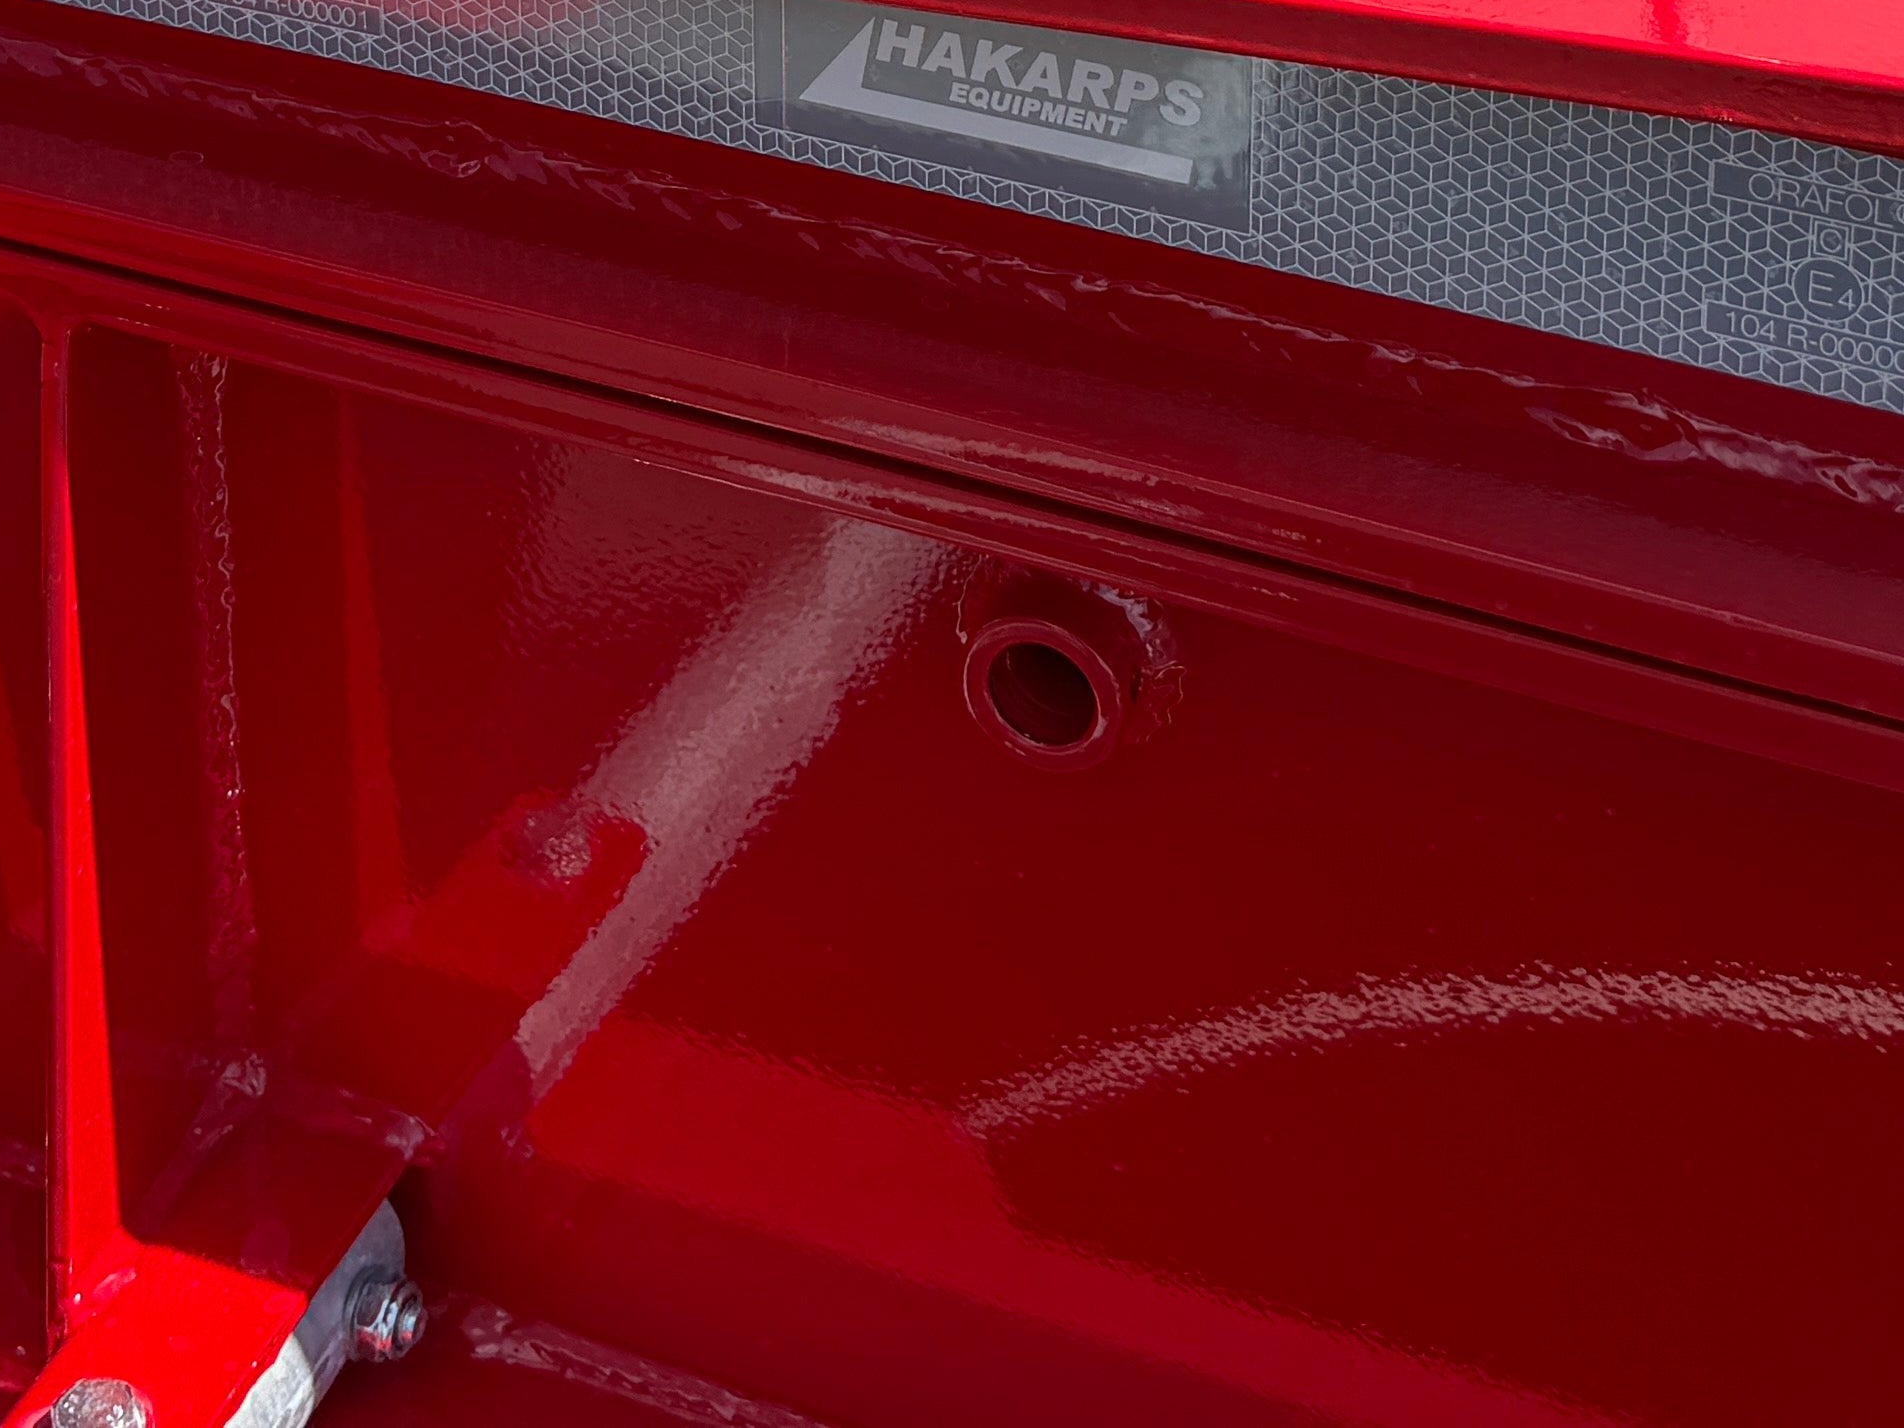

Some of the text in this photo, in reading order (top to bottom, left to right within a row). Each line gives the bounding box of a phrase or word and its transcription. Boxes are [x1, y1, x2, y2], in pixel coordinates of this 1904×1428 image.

[874, 18, 1205, 127] HAKARPS
[948, 82, 1129, 137] EQUIPMENT
[1725, 311, 1777, 342] 104
